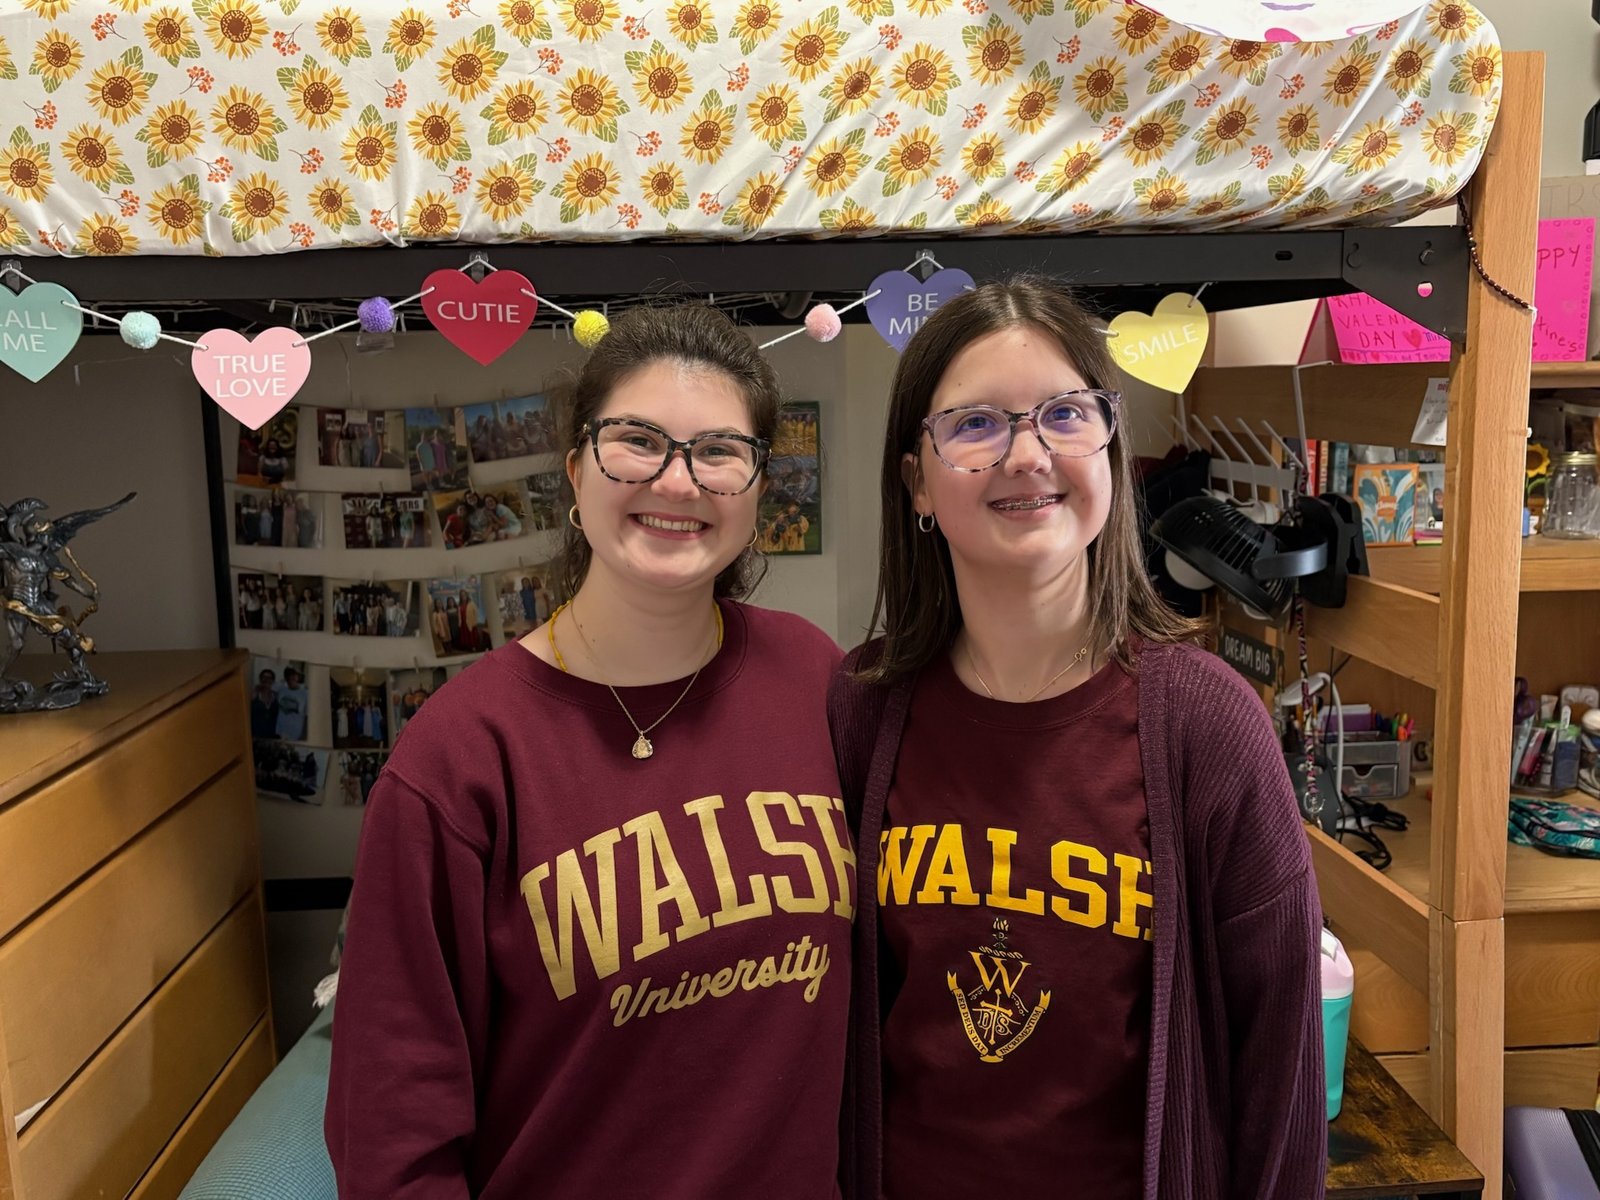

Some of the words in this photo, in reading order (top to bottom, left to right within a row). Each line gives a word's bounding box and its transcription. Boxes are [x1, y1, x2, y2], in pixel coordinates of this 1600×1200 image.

[437, 301, 521, 323] CUTIE
[908, 292, 938, 312] BE
[0, 309, 57, 331] ALL
[3, 332, 47, 352] ME
[1123, 322, 1199, 364] SMILE
[1358, 330, 1397, 349] DAY
[213, 354, 286, 374] TRUE
[216, 378, 287, 398] LOVE
[1225, 635, 1253, 669] DREAM
[1255, 649, 1270, 676] BIG
[520, 791, 857, 1001] WALSH
[877, 824, 1153, 941] WALSH
[609, 936, 830, 1027] University
[967, 950, 1032, 998] W
[962, 1011, 975, 1035] DEUS
[1000, 1009, 1041, 1055] INCREMENTUM
